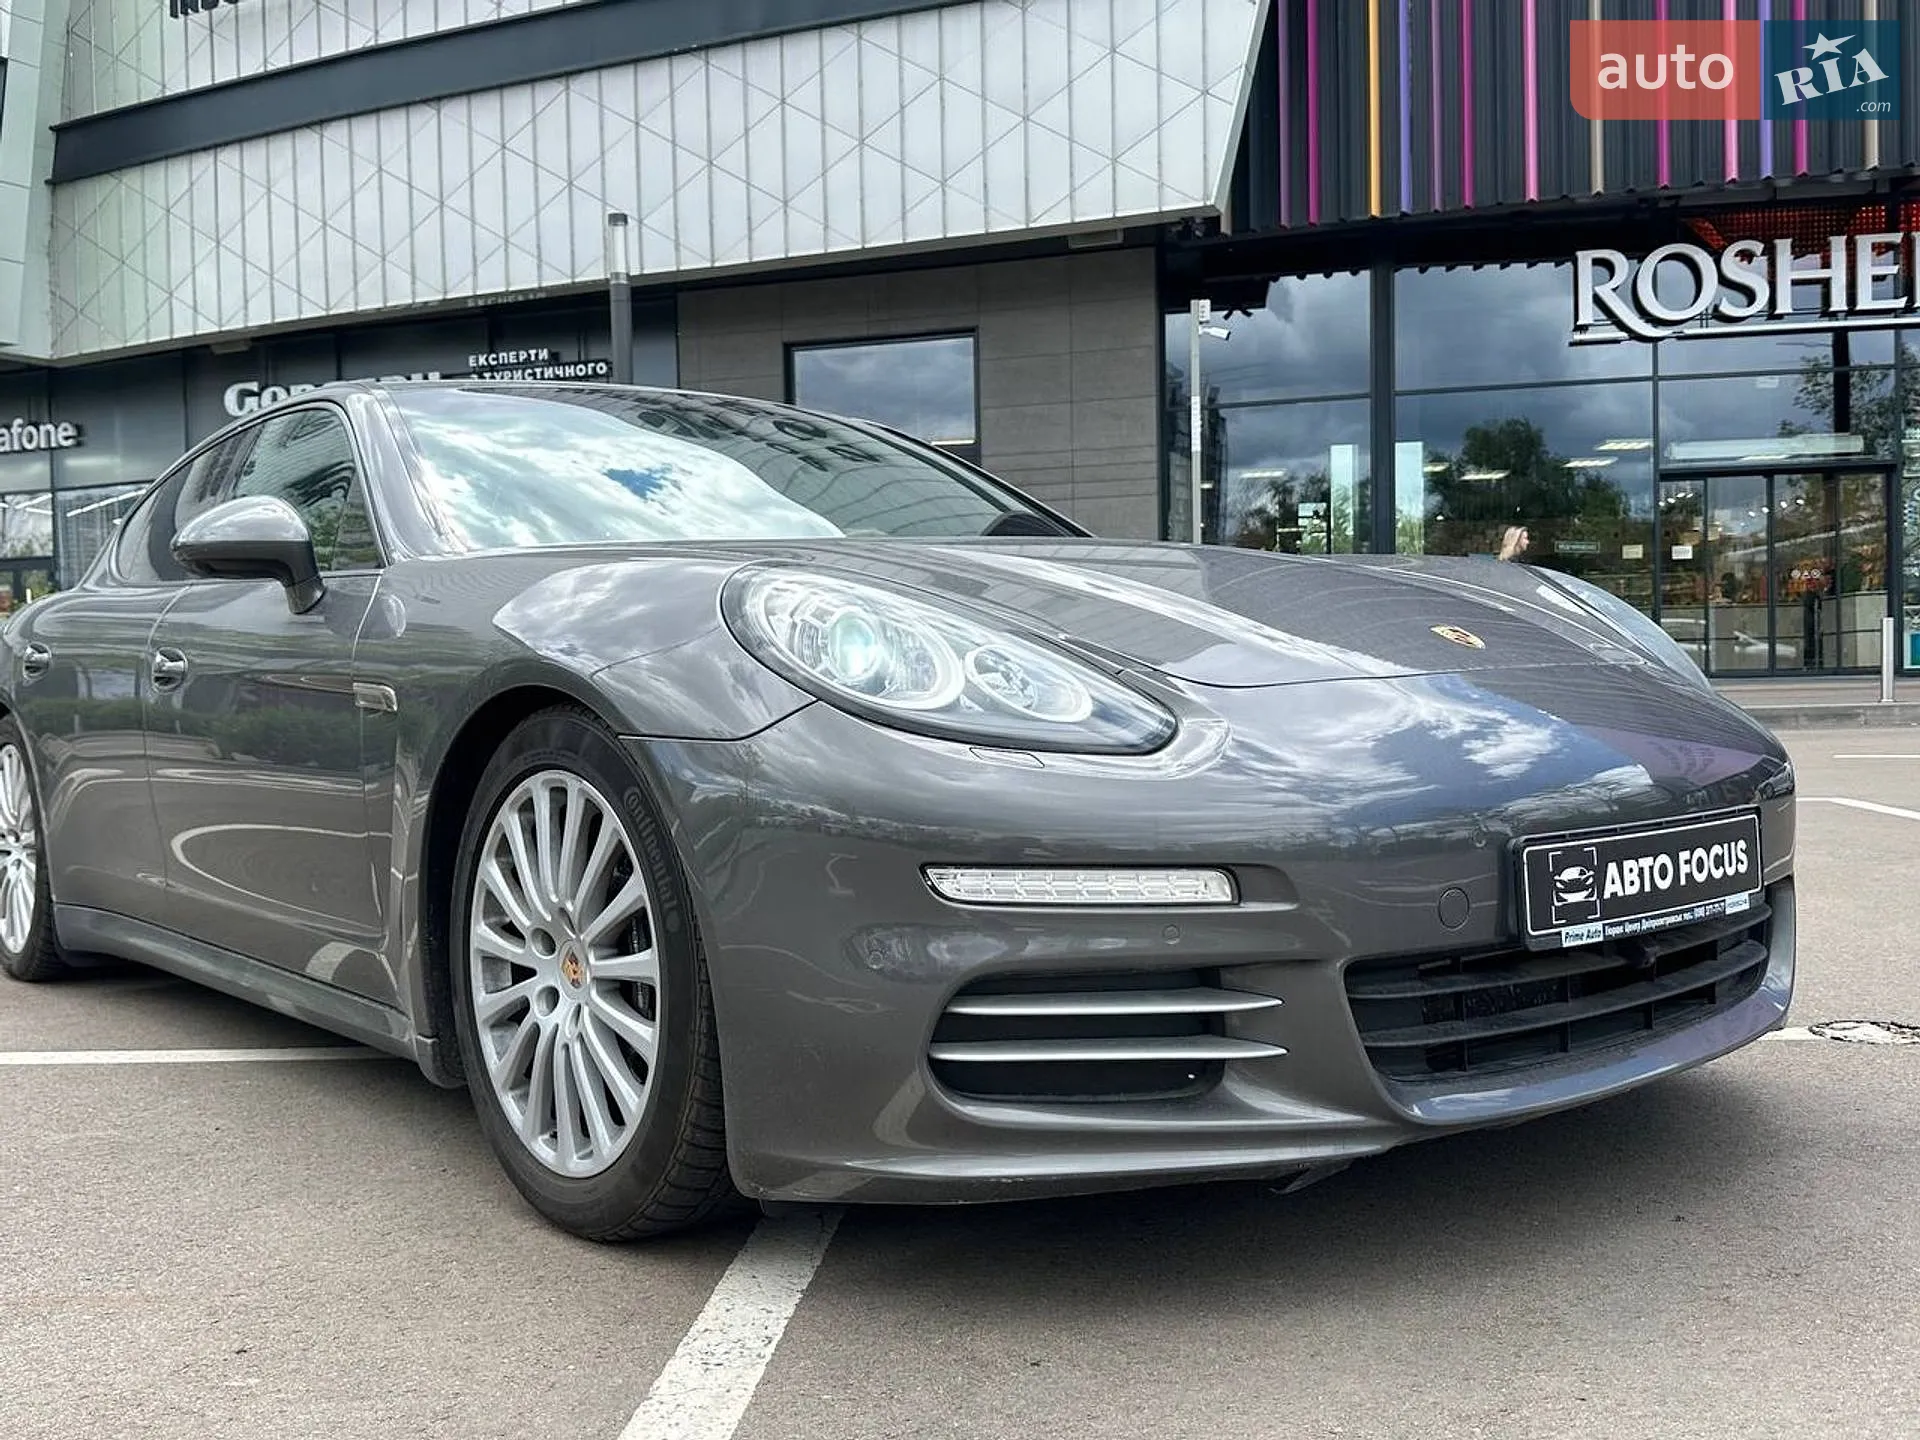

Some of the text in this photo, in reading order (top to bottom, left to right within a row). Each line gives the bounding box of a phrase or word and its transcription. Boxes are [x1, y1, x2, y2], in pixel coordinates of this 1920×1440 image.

[1576, 232, 1920, 338] ROSHE
[468, 348, 549, 367] ЕКСПЕРТИ
[1678, 839, 1749, 886] FOCUS
